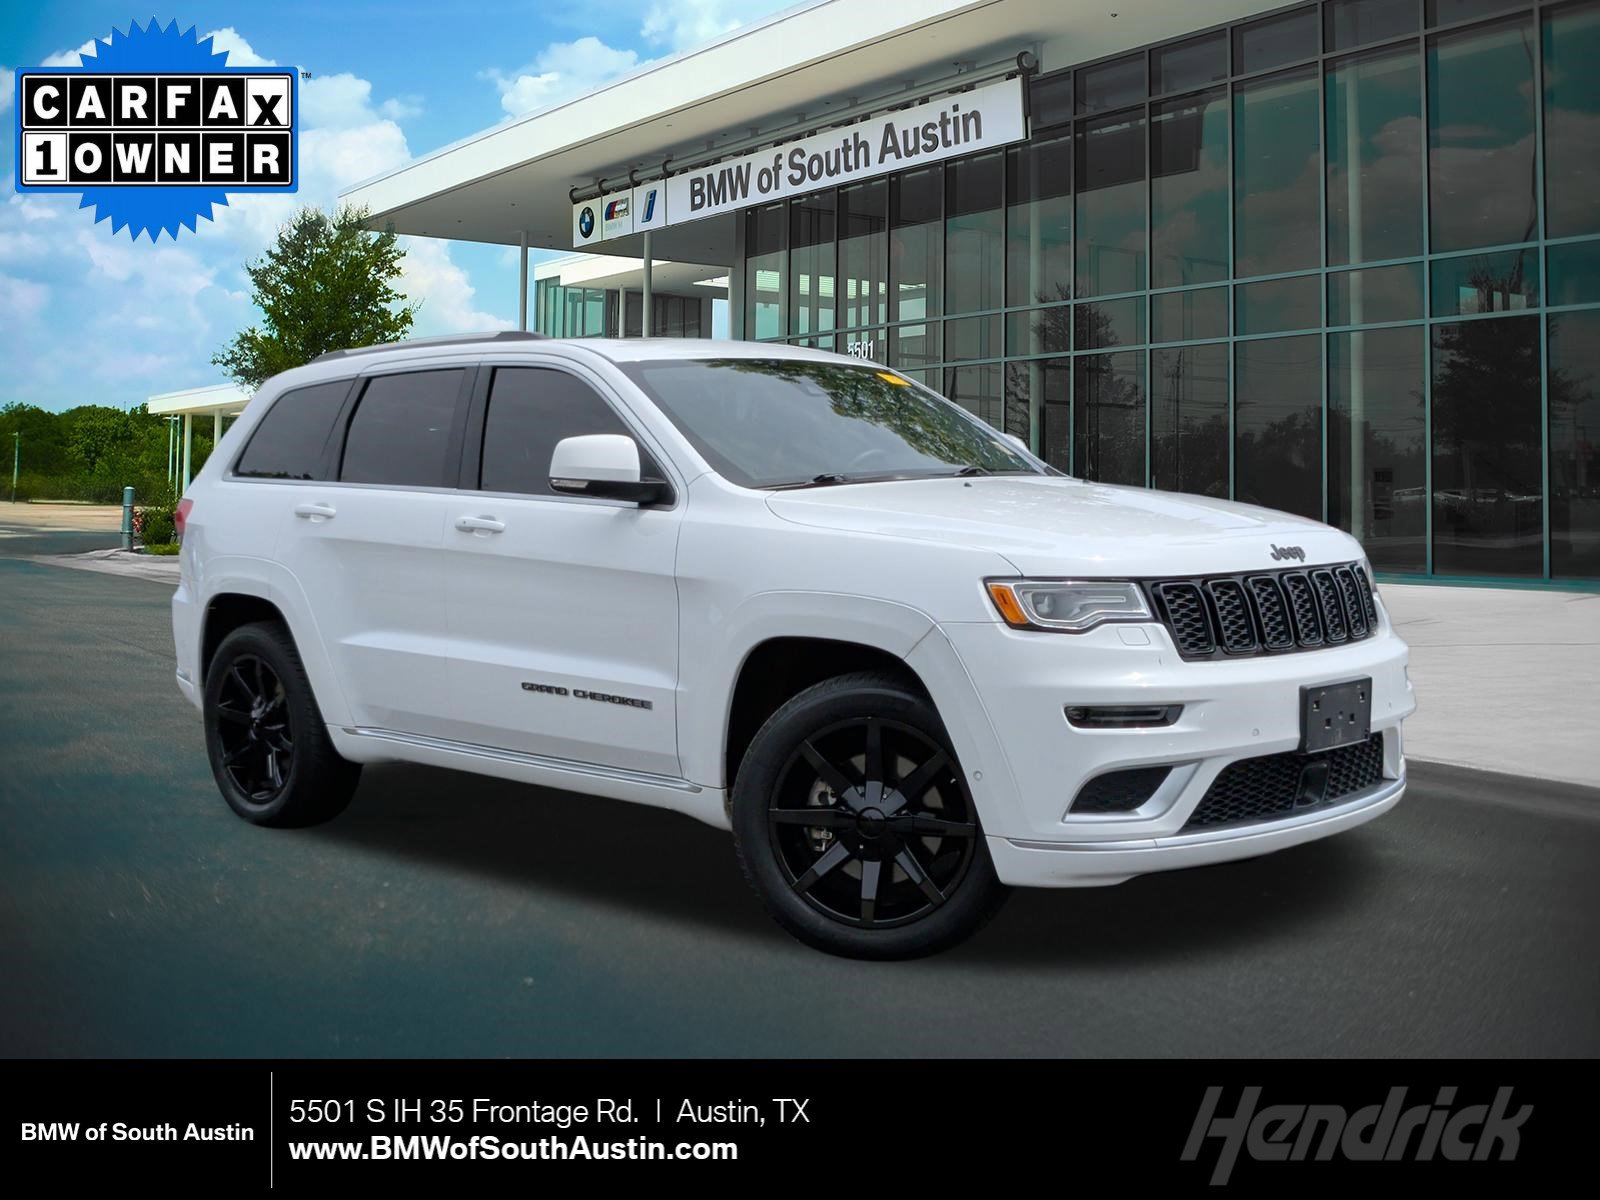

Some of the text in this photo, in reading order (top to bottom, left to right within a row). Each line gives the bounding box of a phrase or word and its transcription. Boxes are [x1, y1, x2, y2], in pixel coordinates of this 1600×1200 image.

[690, 162, 751, 211] BMW
[757, 153, 782, 194] of
[788, 132, 870, 186] South
[878, 104, 982, 165] Austin
[847, 340, 874, 359] 5501
[1270, 543, 1306, 562] Jeep
[521, 682, 653, 710] GRAND CHEROKEE
